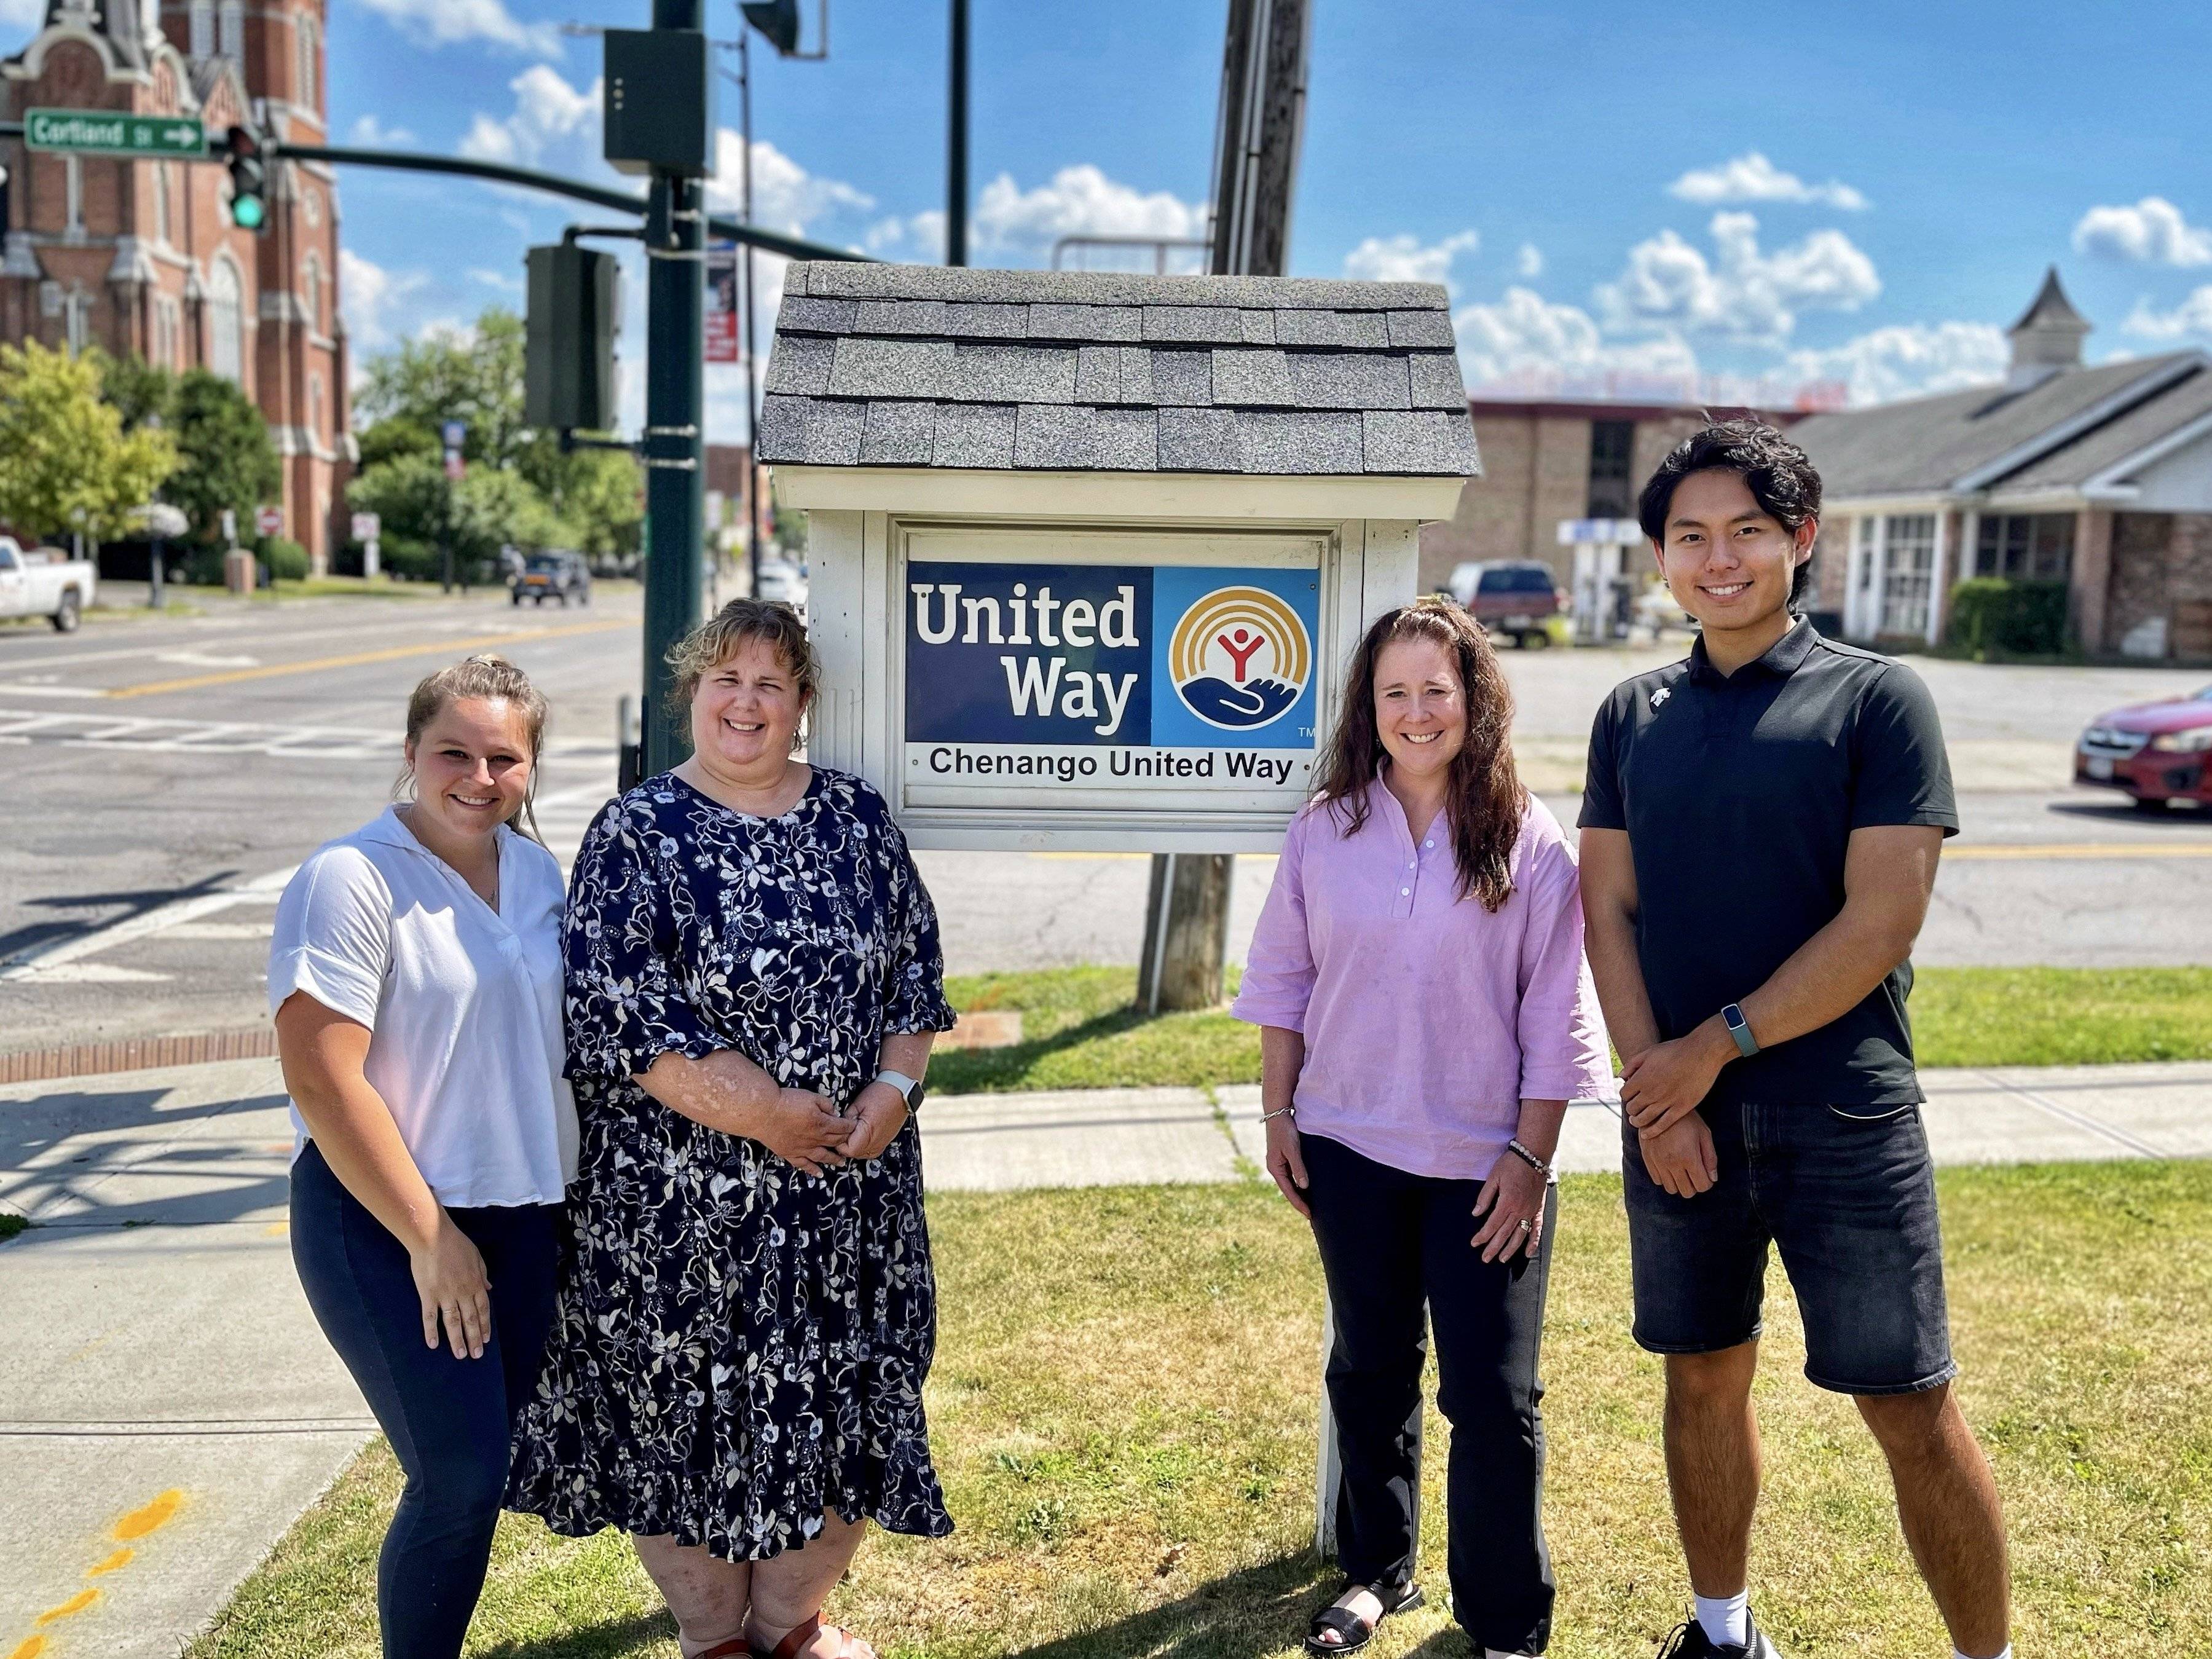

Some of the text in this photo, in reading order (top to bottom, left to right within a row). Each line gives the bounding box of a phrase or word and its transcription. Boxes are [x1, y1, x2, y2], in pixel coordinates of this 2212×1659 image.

[34, 116, 124, 144] Cortland
[911, 583, 1139, 648] United
[1000, 656, 1138, 736] Way
[929, 747, 1293, 785] Chenango United Way
